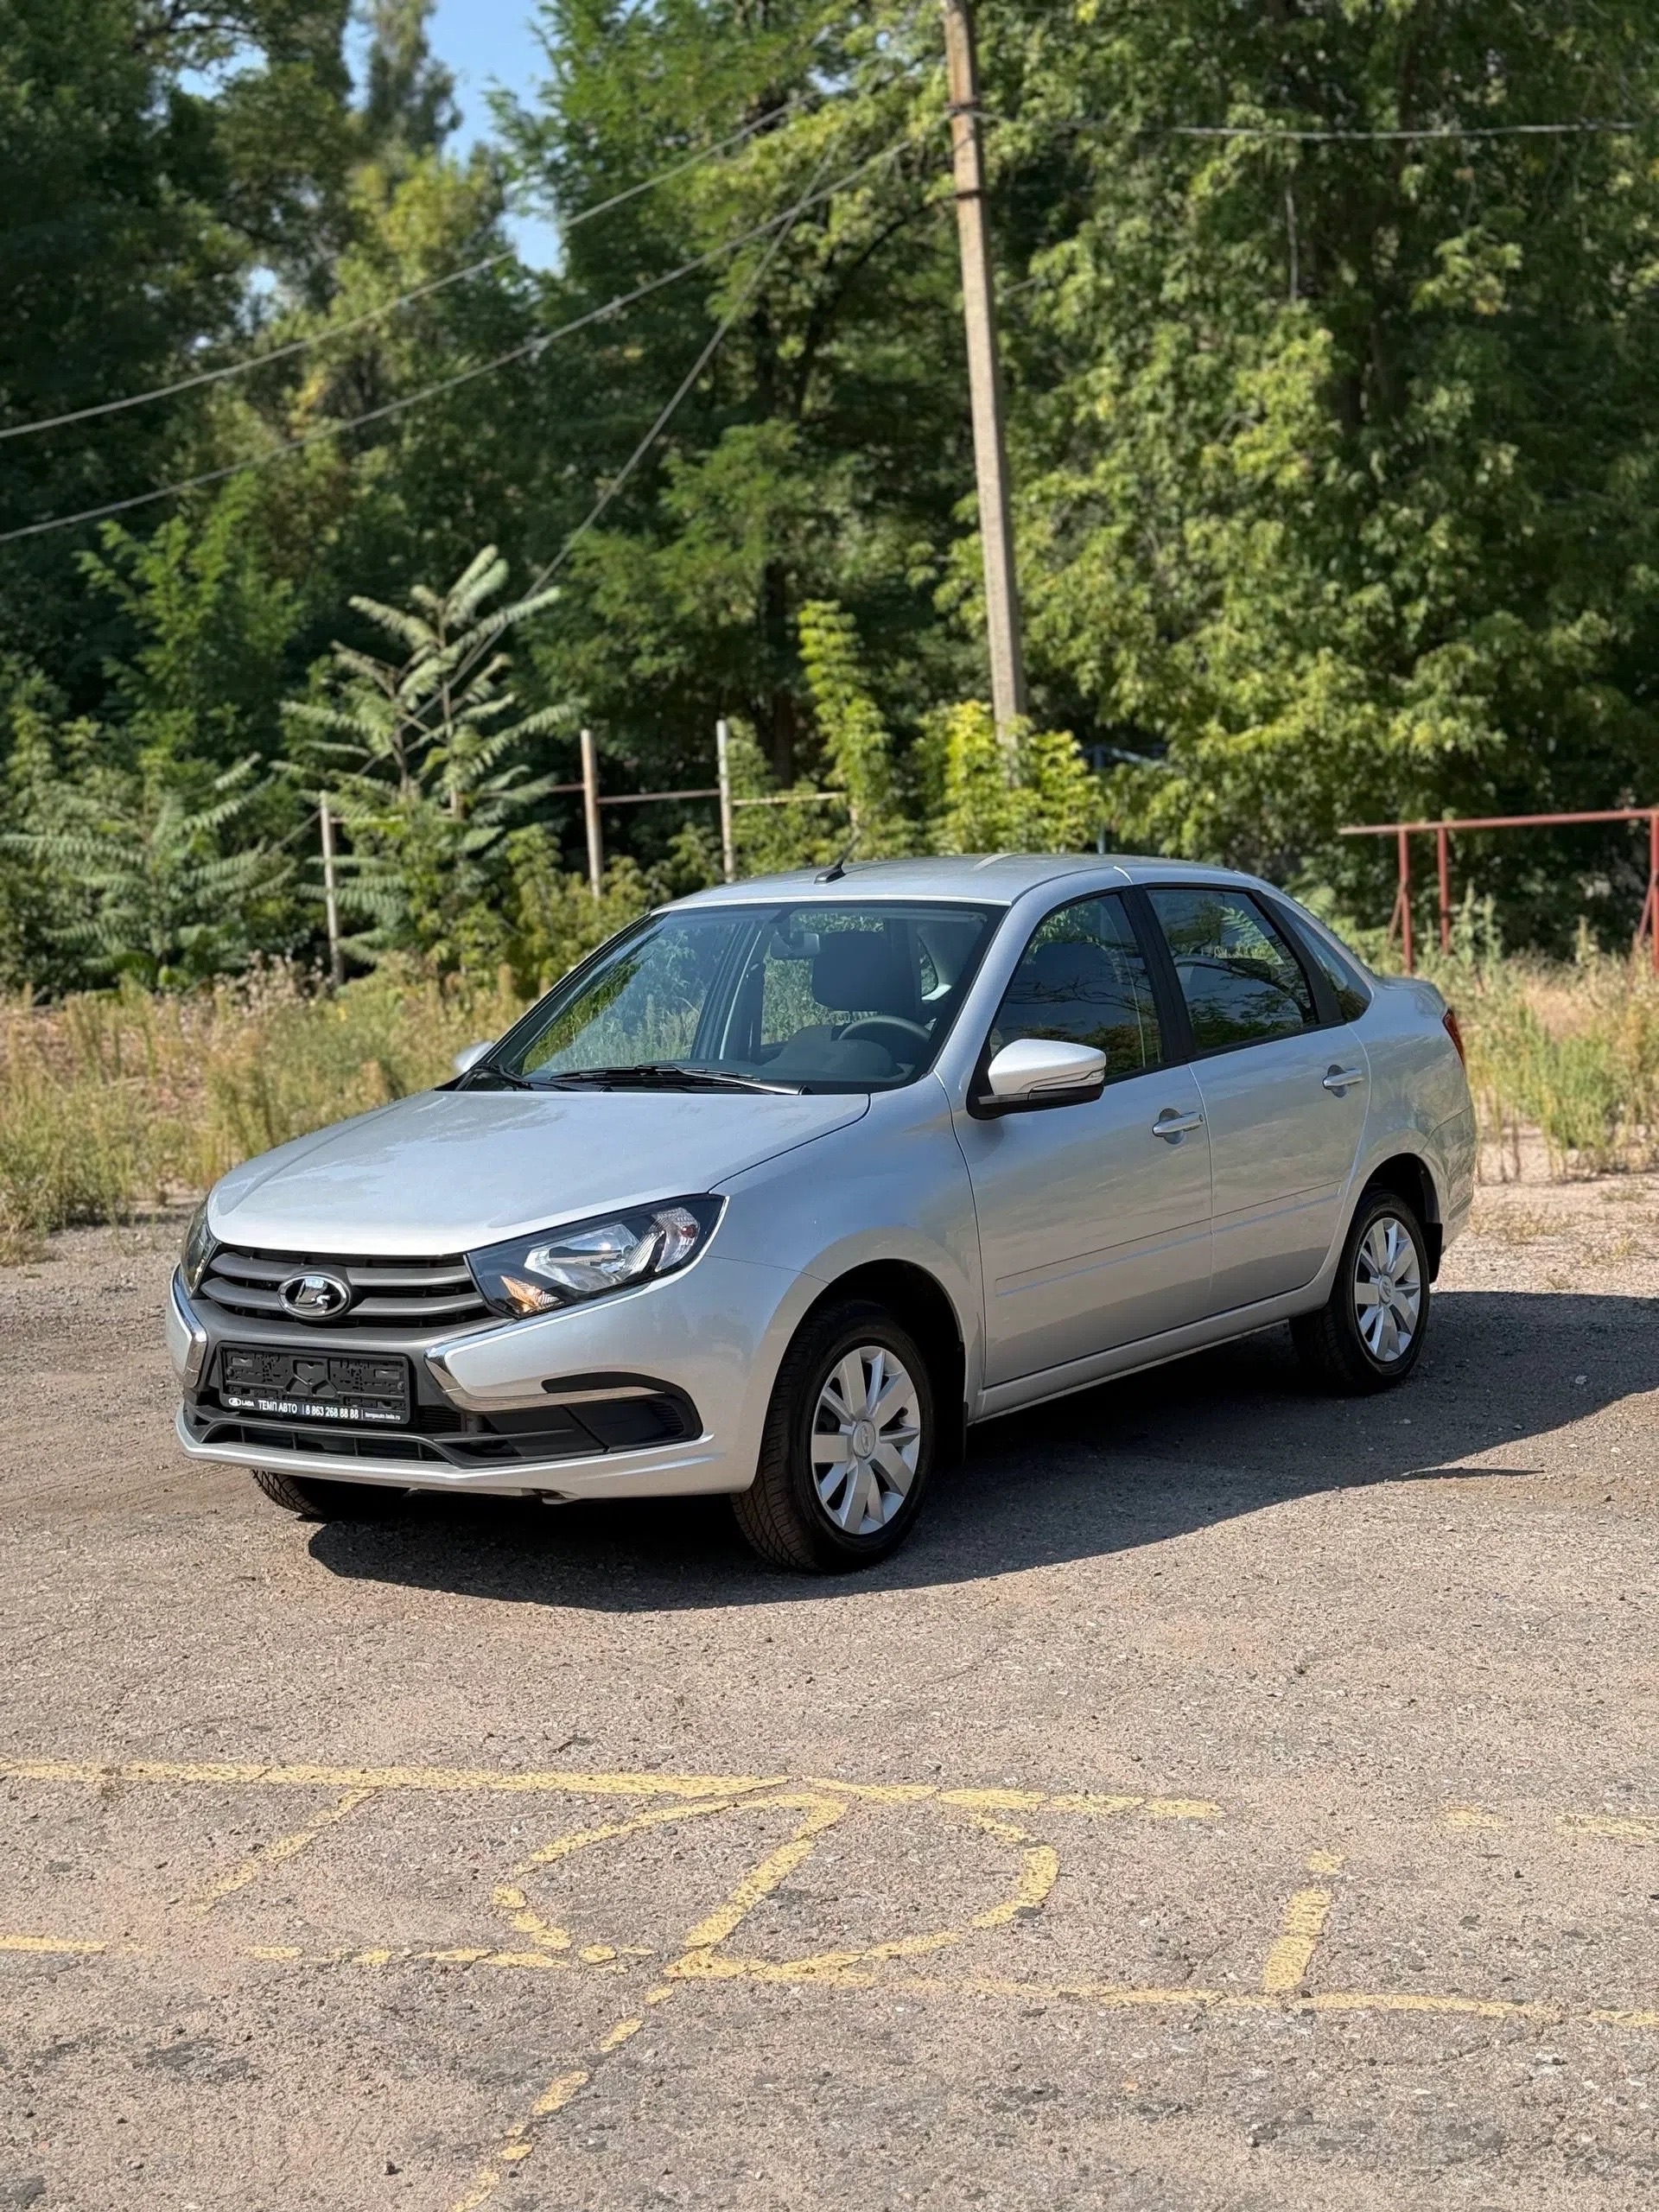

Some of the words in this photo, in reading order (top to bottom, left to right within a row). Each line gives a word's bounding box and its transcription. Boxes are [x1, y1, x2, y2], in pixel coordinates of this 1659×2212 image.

[257, 1400, 277, 1411] ТЕМП
[278, 1402, 298, 1414] АВТО
[305, 1404, 310, 1415] 8
[311, 1405, 324, 1417] 863
[325, 1406, 339, 1417] 268
[340, 1408, 348, 1418] 88
[350, 1408, 359, 1419] 88
